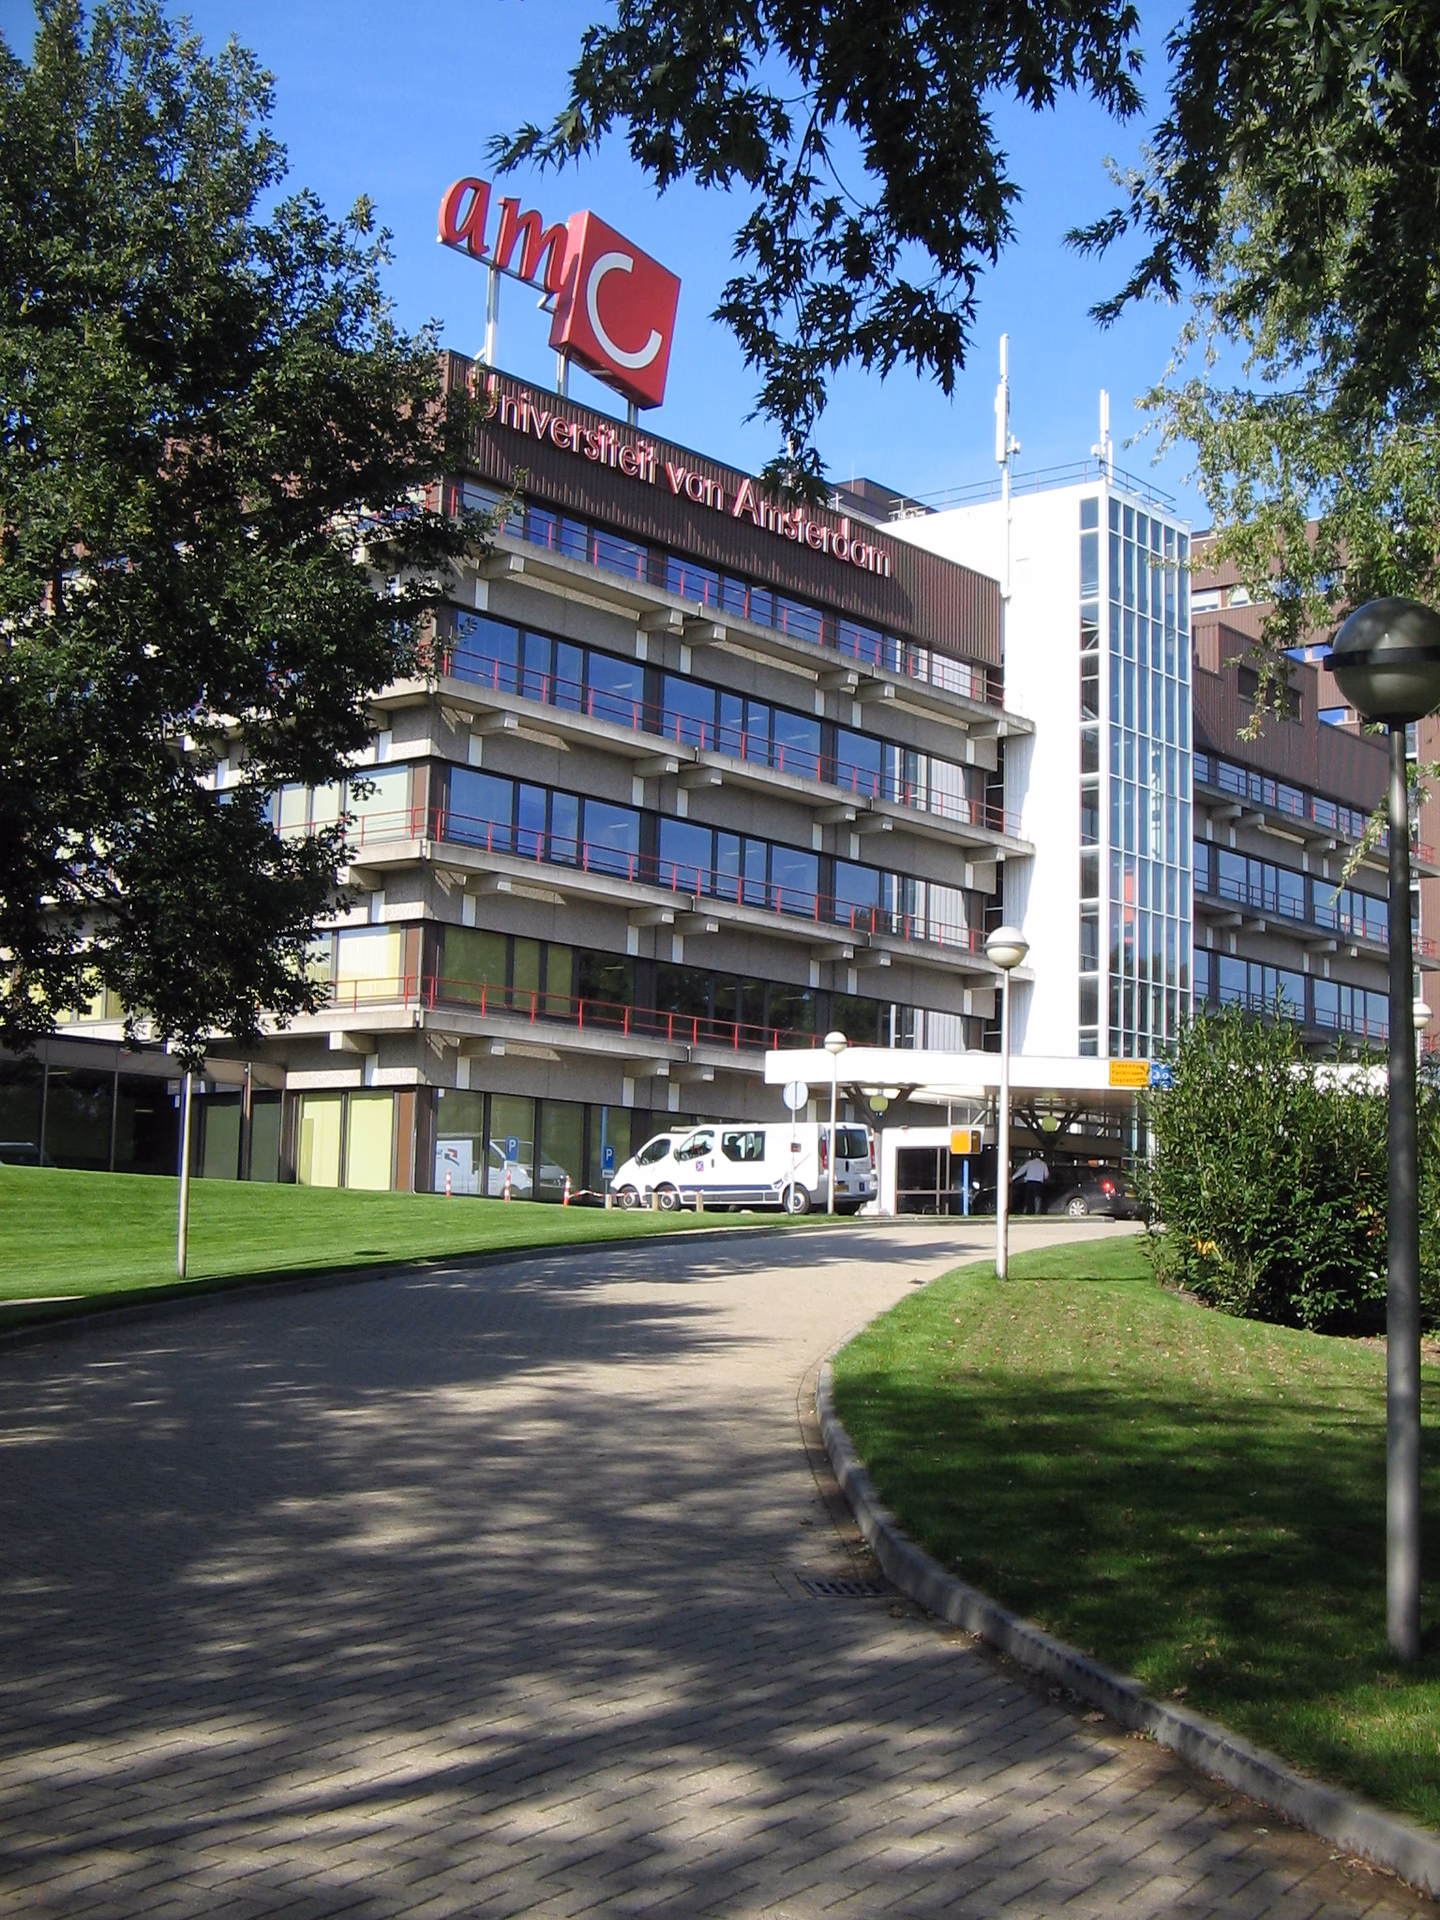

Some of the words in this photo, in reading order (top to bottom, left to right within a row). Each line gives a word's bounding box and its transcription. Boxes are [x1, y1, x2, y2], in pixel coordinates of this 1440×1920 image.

[467, 365, 658, 486] Universiteit
[666, 461, 725, 512] van
[732, 477, 893, 579] Amsterdam
[508, 1139, 516, 1152] P
[605, 1148, 613, 1161] P
